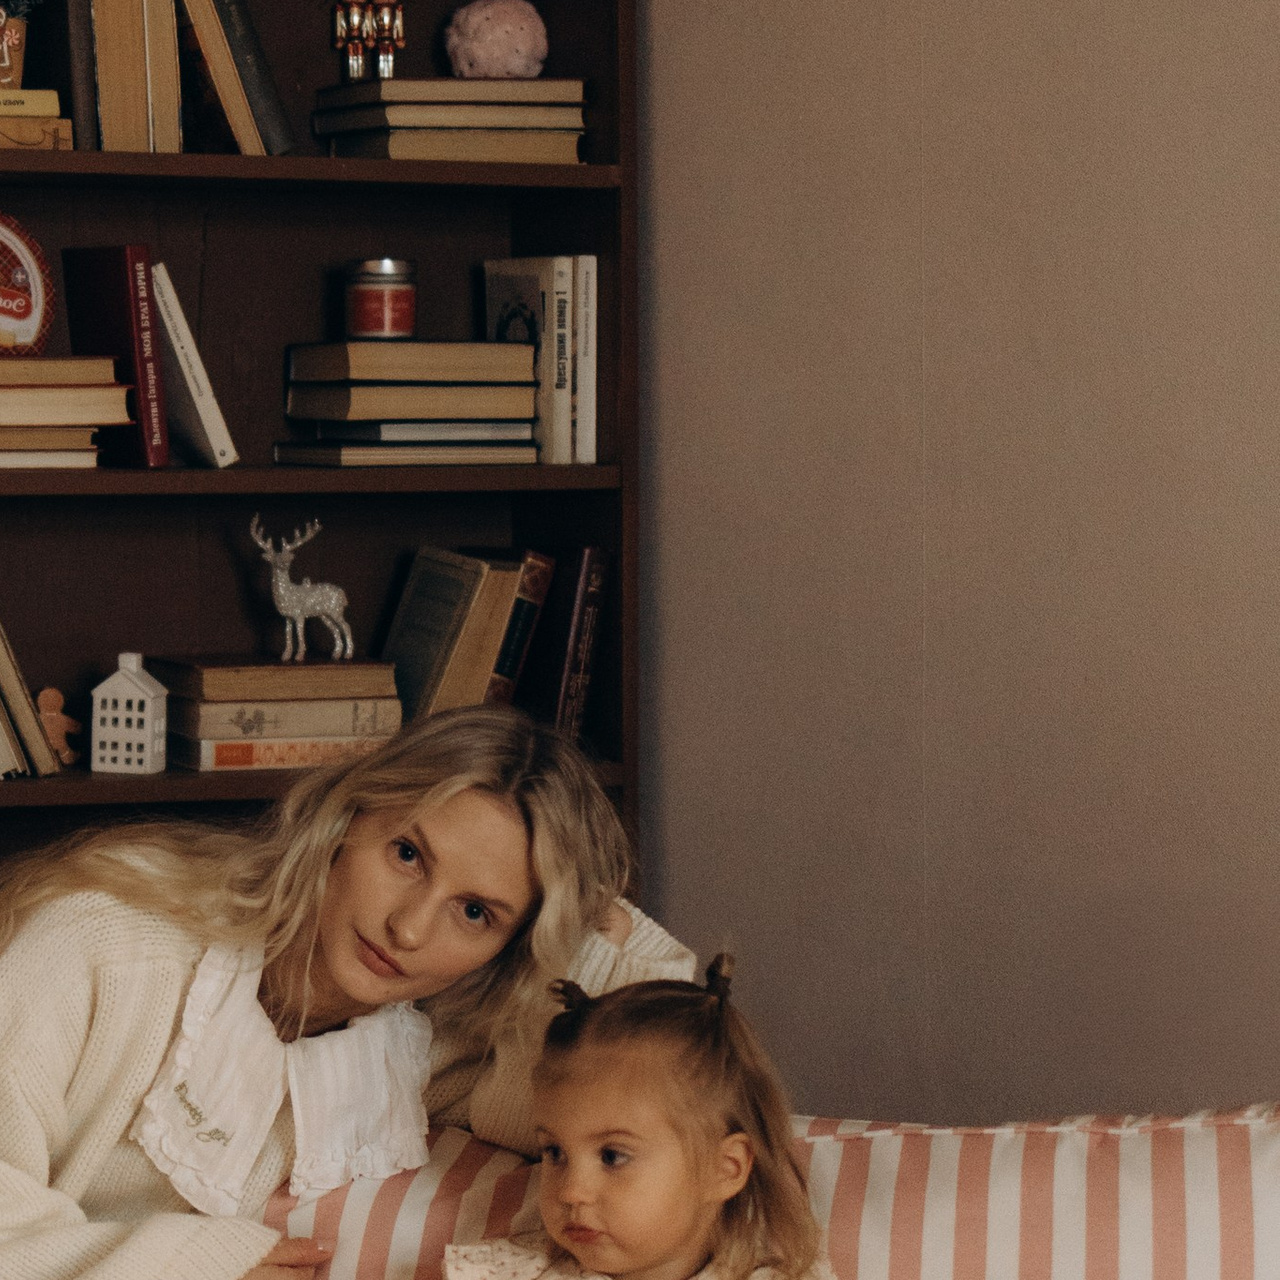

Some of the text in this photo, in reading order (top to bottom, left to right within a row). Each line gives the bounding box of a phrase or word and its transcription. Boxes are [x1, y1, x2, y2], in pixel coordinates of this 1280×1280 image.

[2, 98, 25, 106] КАРЕЛ
[133, 261, 154, 358] МОЙ БРАТ ЮРИЙ
[556, 297, 568, 329] номер
[554, 331, 568, 390] Преступник
[142, 360, 162, 445] Валентин Гагарин
